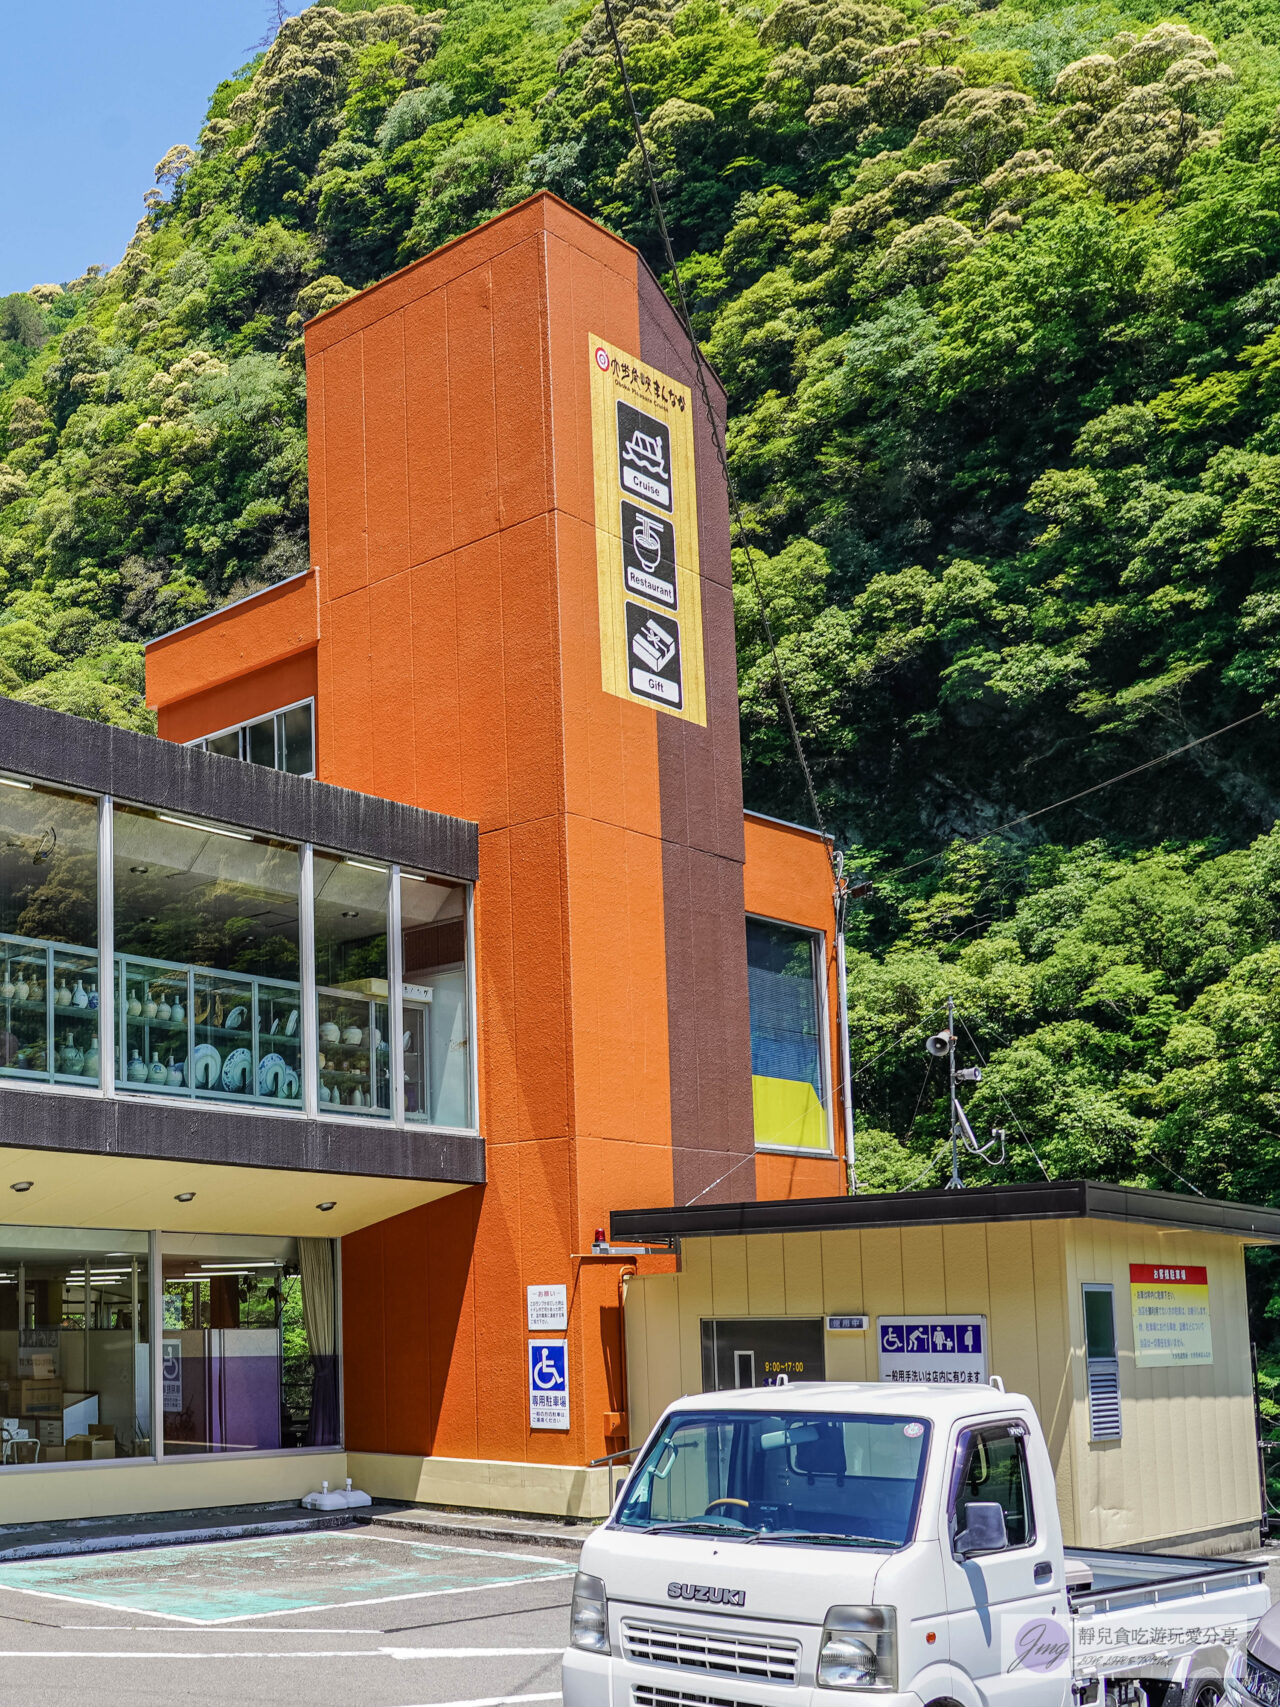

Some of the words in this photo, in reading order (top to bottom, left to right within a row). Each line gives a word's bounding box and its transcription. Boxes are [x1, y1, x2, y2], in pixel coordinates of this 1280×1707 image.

[632, 475, 660, 497] Cruise
[630, 571, 672, 599] Restaurant
[648, 678, 664, 693] Gift
[885, 1370, 981, 1383] 一般用手洗いは店内に有ります
[532, 1395, 567, 1408] 専用駐車場
[667, 1582, 746, 1607] SUZUKI
